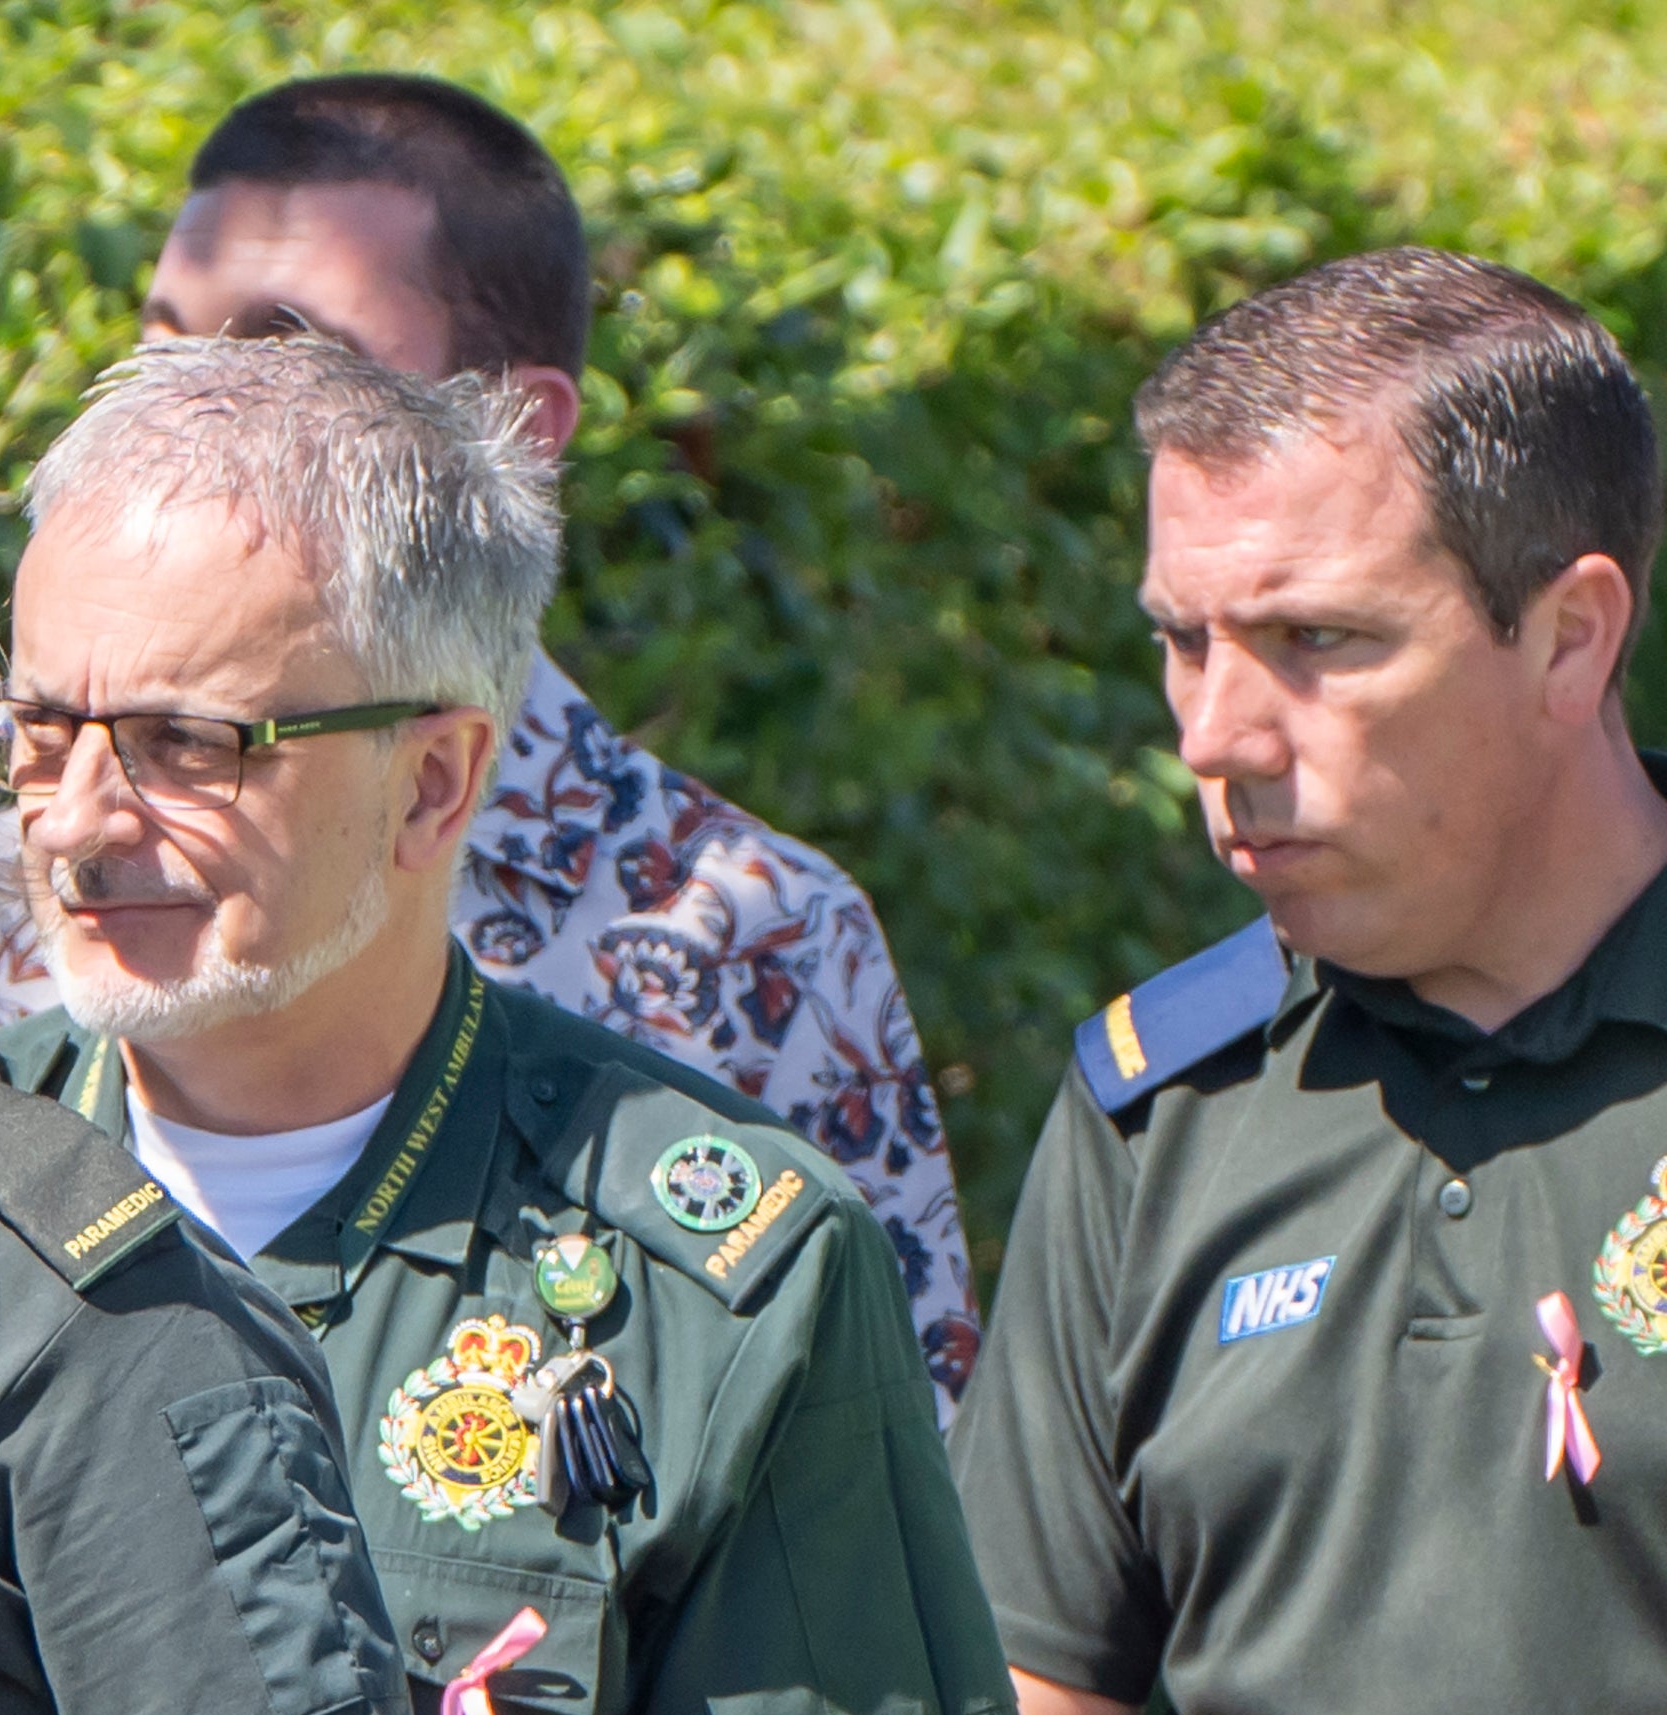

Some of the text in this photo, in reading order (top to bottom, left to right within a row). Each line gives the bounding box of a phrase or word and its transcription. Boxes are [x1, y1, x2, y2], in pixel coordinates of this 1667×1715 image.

[355, 1151, 416, 1235] NORTH
[407, 1085, 450, 1151] WEST
[63, 1181, 164, 1260] PARAMEDIC
[705, 1169, 805, 1280] PARAMEDIC
[1228, 1261, 1330, 1335] NHS
